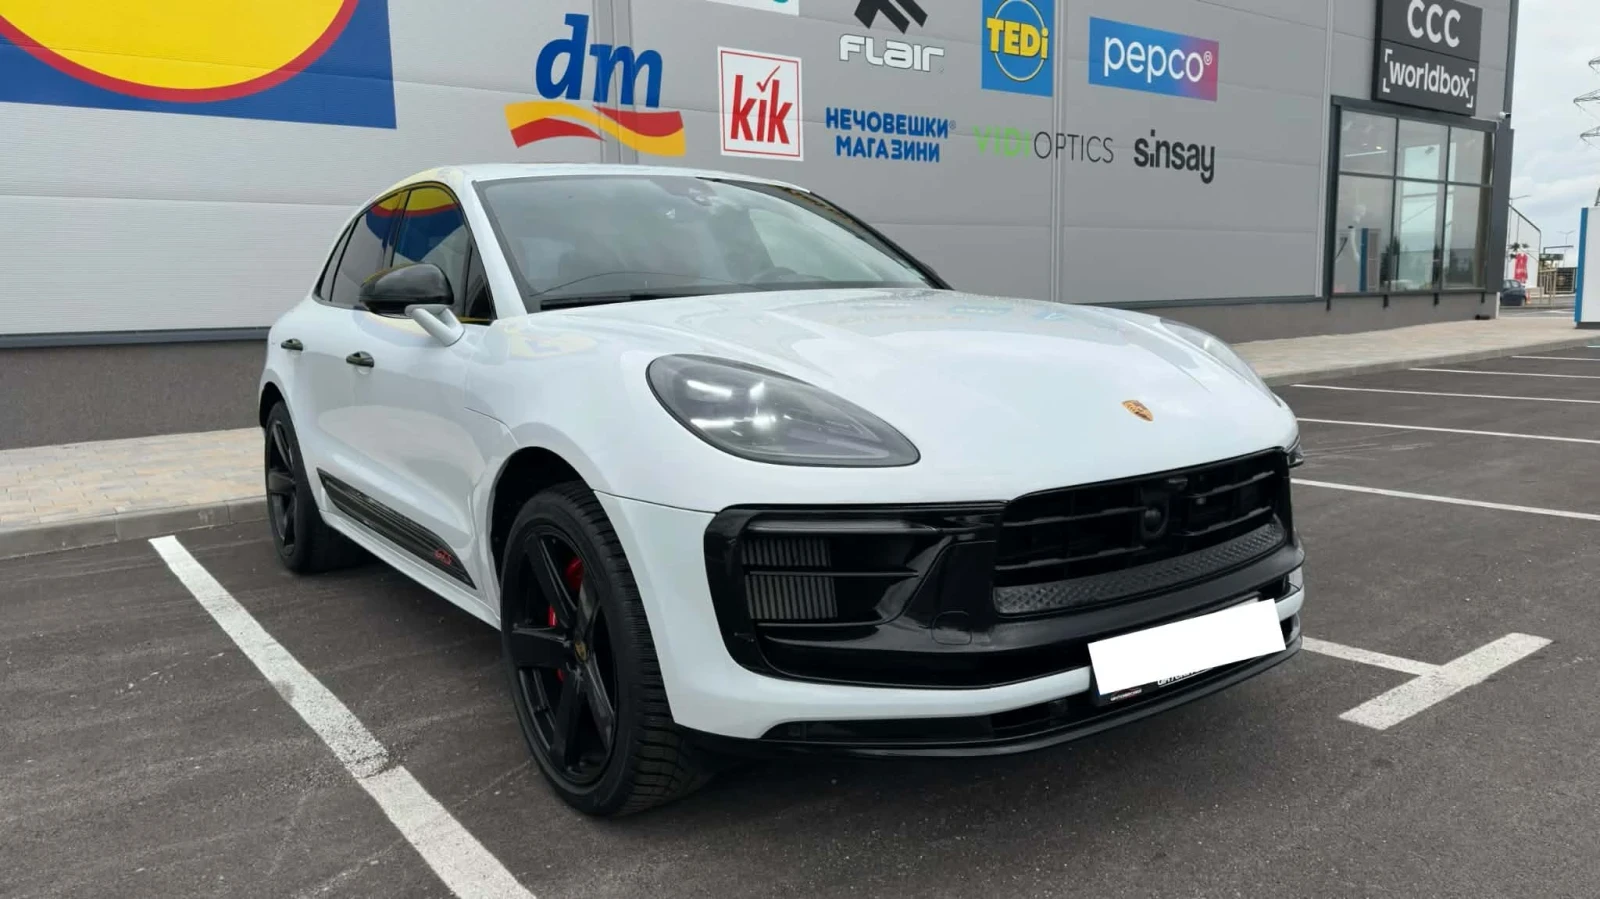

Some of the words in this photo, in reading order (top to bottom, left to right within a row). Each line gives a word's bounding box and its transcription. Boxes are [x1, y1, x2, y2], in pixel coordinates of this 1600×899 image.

[986, 17, 1049, 60] TEDi
[1407, 0, 1461, 47] CCC
[535, 13, 663, 108] dm
[1388, 60, 1470, 98] worldbox
[836, 135, 940, 163] МАГАЗИНИ
[1134, 129, 1215, 184] sinsay
